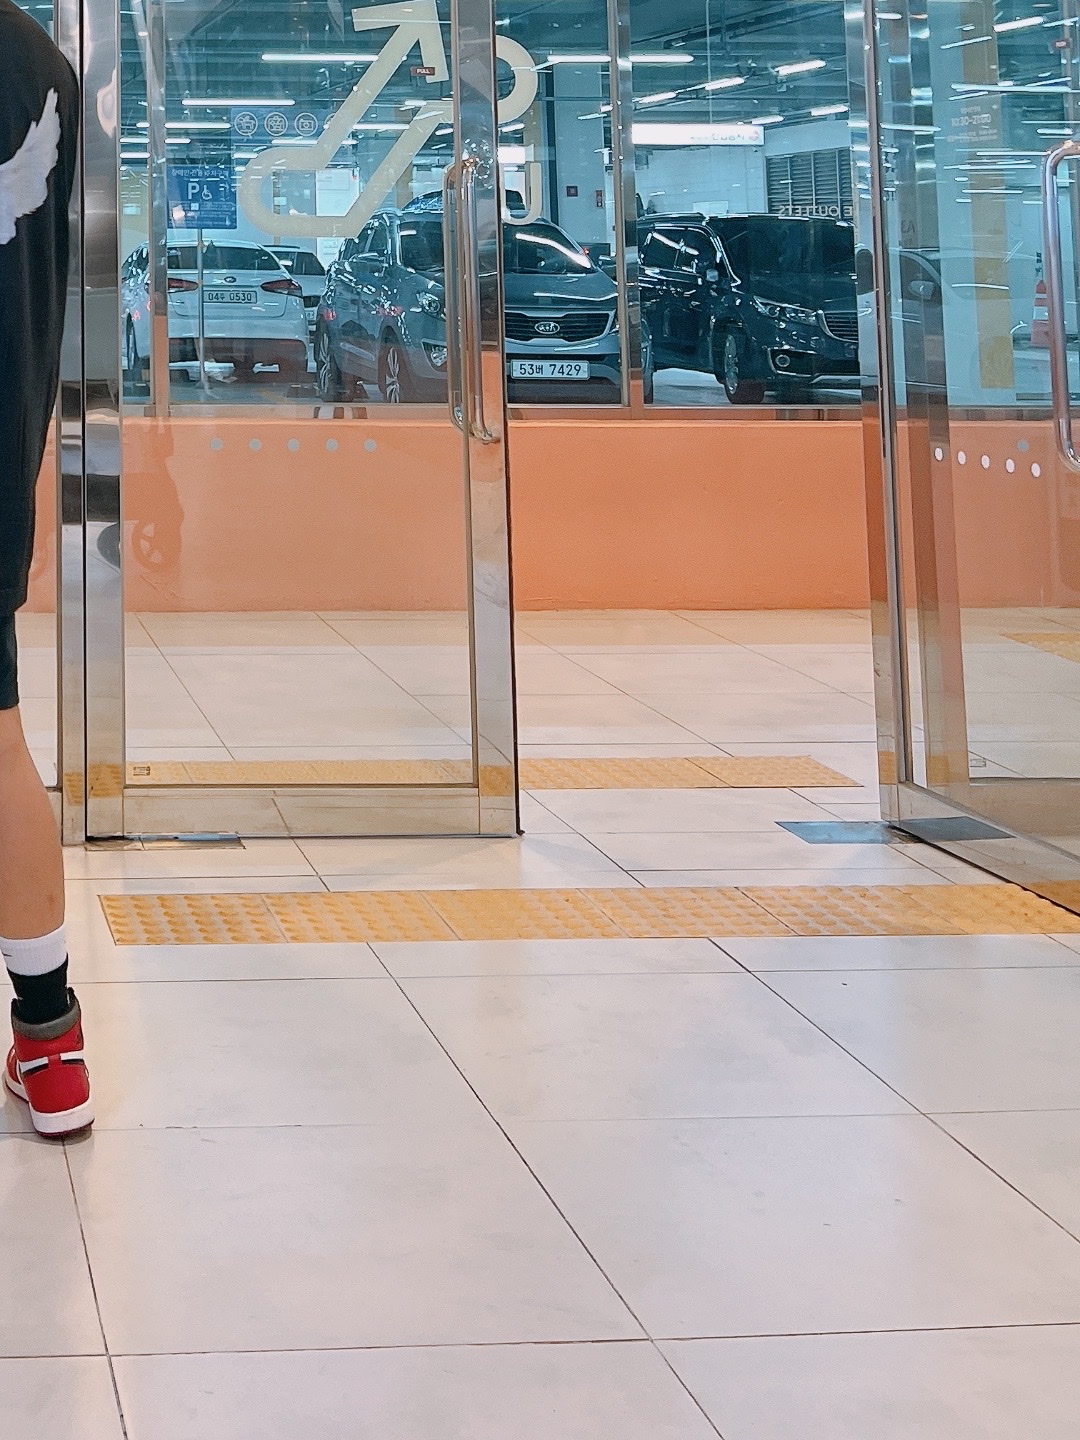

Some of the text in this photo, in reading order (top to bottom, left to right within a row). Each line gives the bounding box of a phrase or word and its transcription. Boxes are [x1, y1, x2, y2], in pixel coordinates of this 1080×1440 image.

[187, 182, 200, 200] P
[229, 292, 252, 302] 0530
[519, 363, 582, 376] 53버 7429
